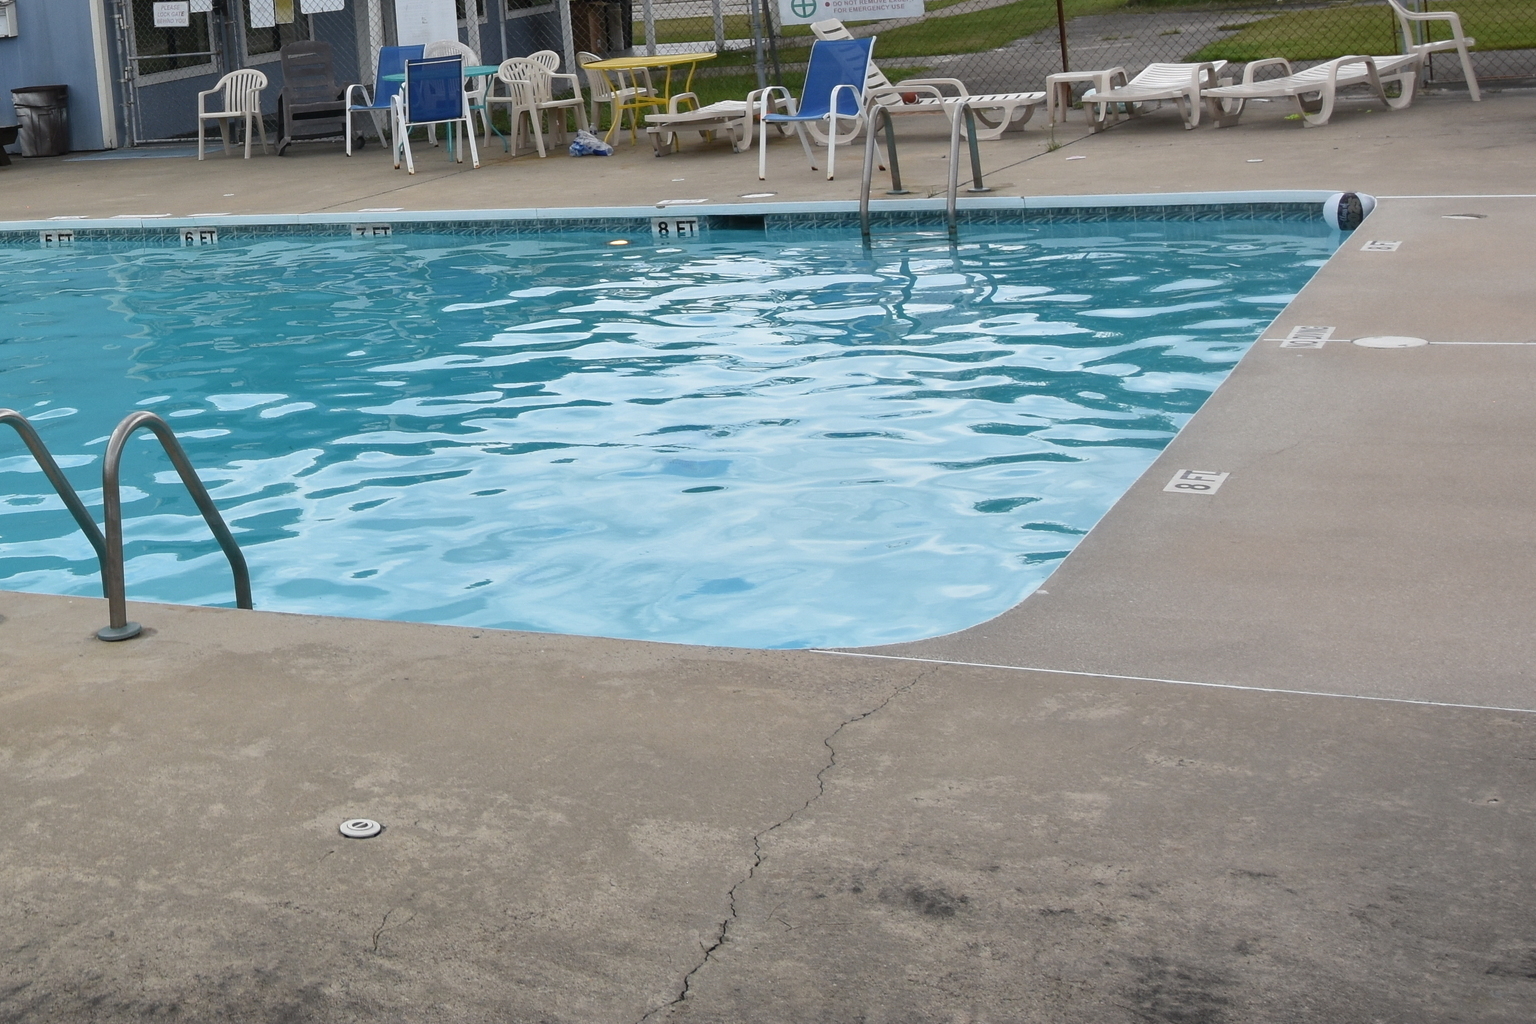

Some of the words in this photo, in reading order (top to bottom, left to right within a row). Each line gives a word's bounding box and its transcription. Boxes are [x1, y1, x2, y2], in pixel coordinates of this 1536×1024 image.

[848, 4, 890, 12] EMERGENCY
[372, 227, 390, 236] FT
[658, 221, 670, 238] 8
[676, 220, 696, 238] FT
[58, 234, 72, 243] FT
[200, 230, 216, 246] FT
